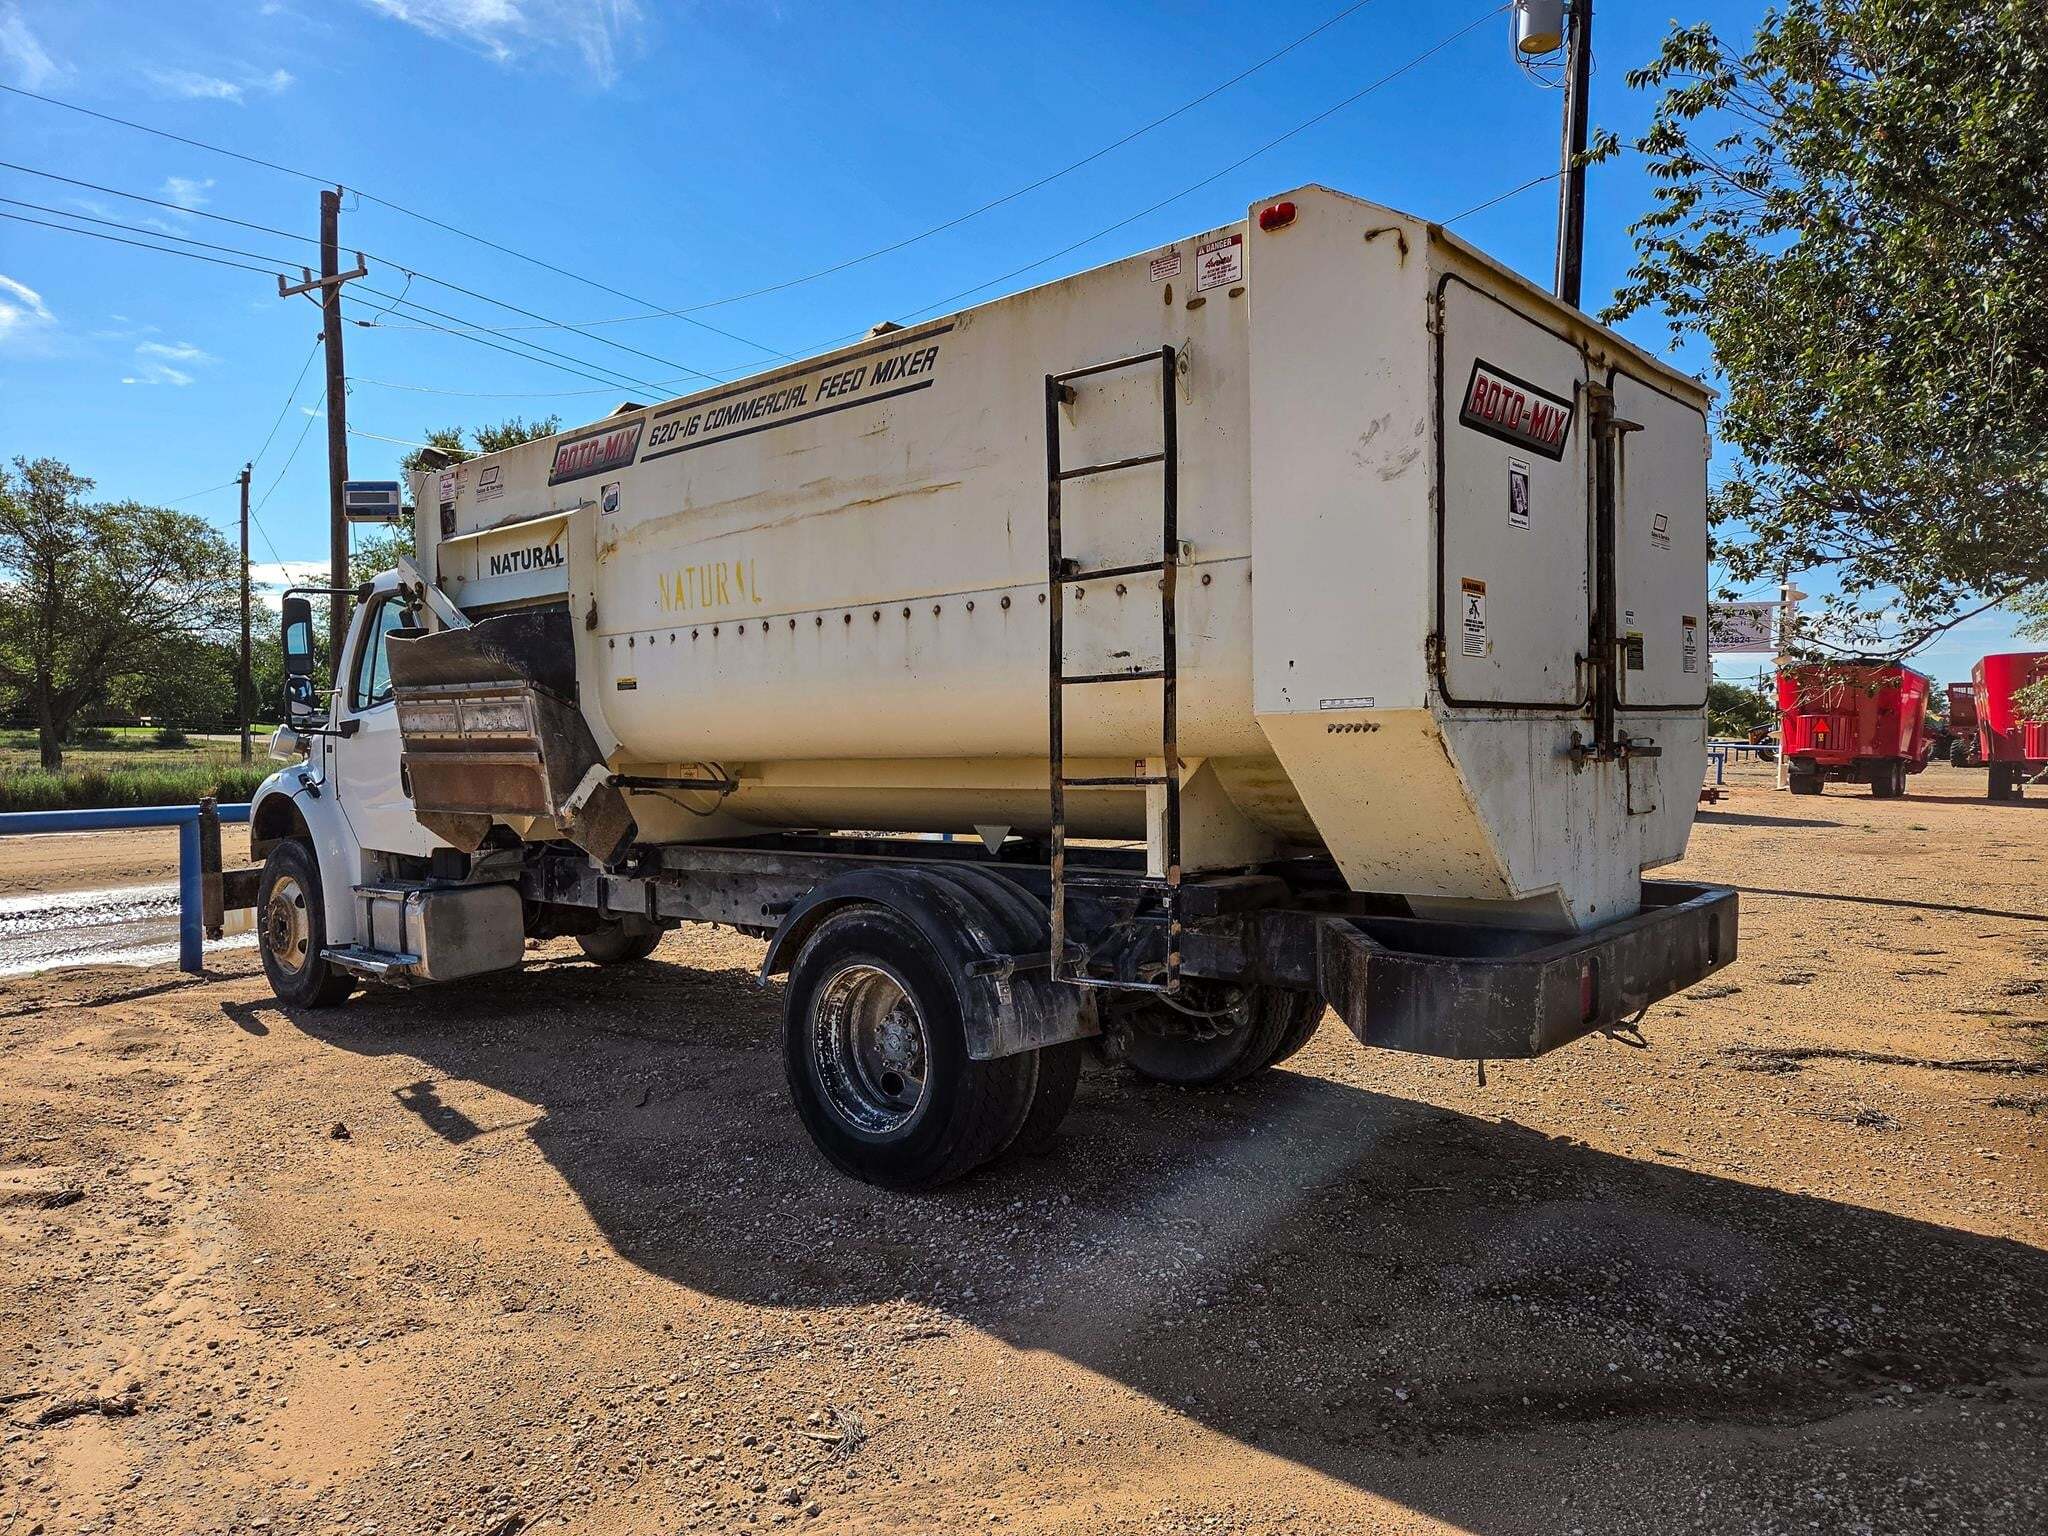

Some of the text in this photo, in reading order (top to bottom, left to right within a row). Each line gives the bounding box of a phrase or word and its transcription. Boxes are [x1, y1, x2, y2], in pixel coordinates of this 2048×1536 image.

[1206, 238, 1232, 252] DANGER
[648, 345, 940, 447] 620-16 COMMERCIAL FEED MIXER
[1469, 374, 1568, 447] ROTO-MIX
[556, 427, 639, 475] ROTO-MIX
[490, 543, 565, 576] NATURAL
[1709, 636, 1751, 644] 242824
